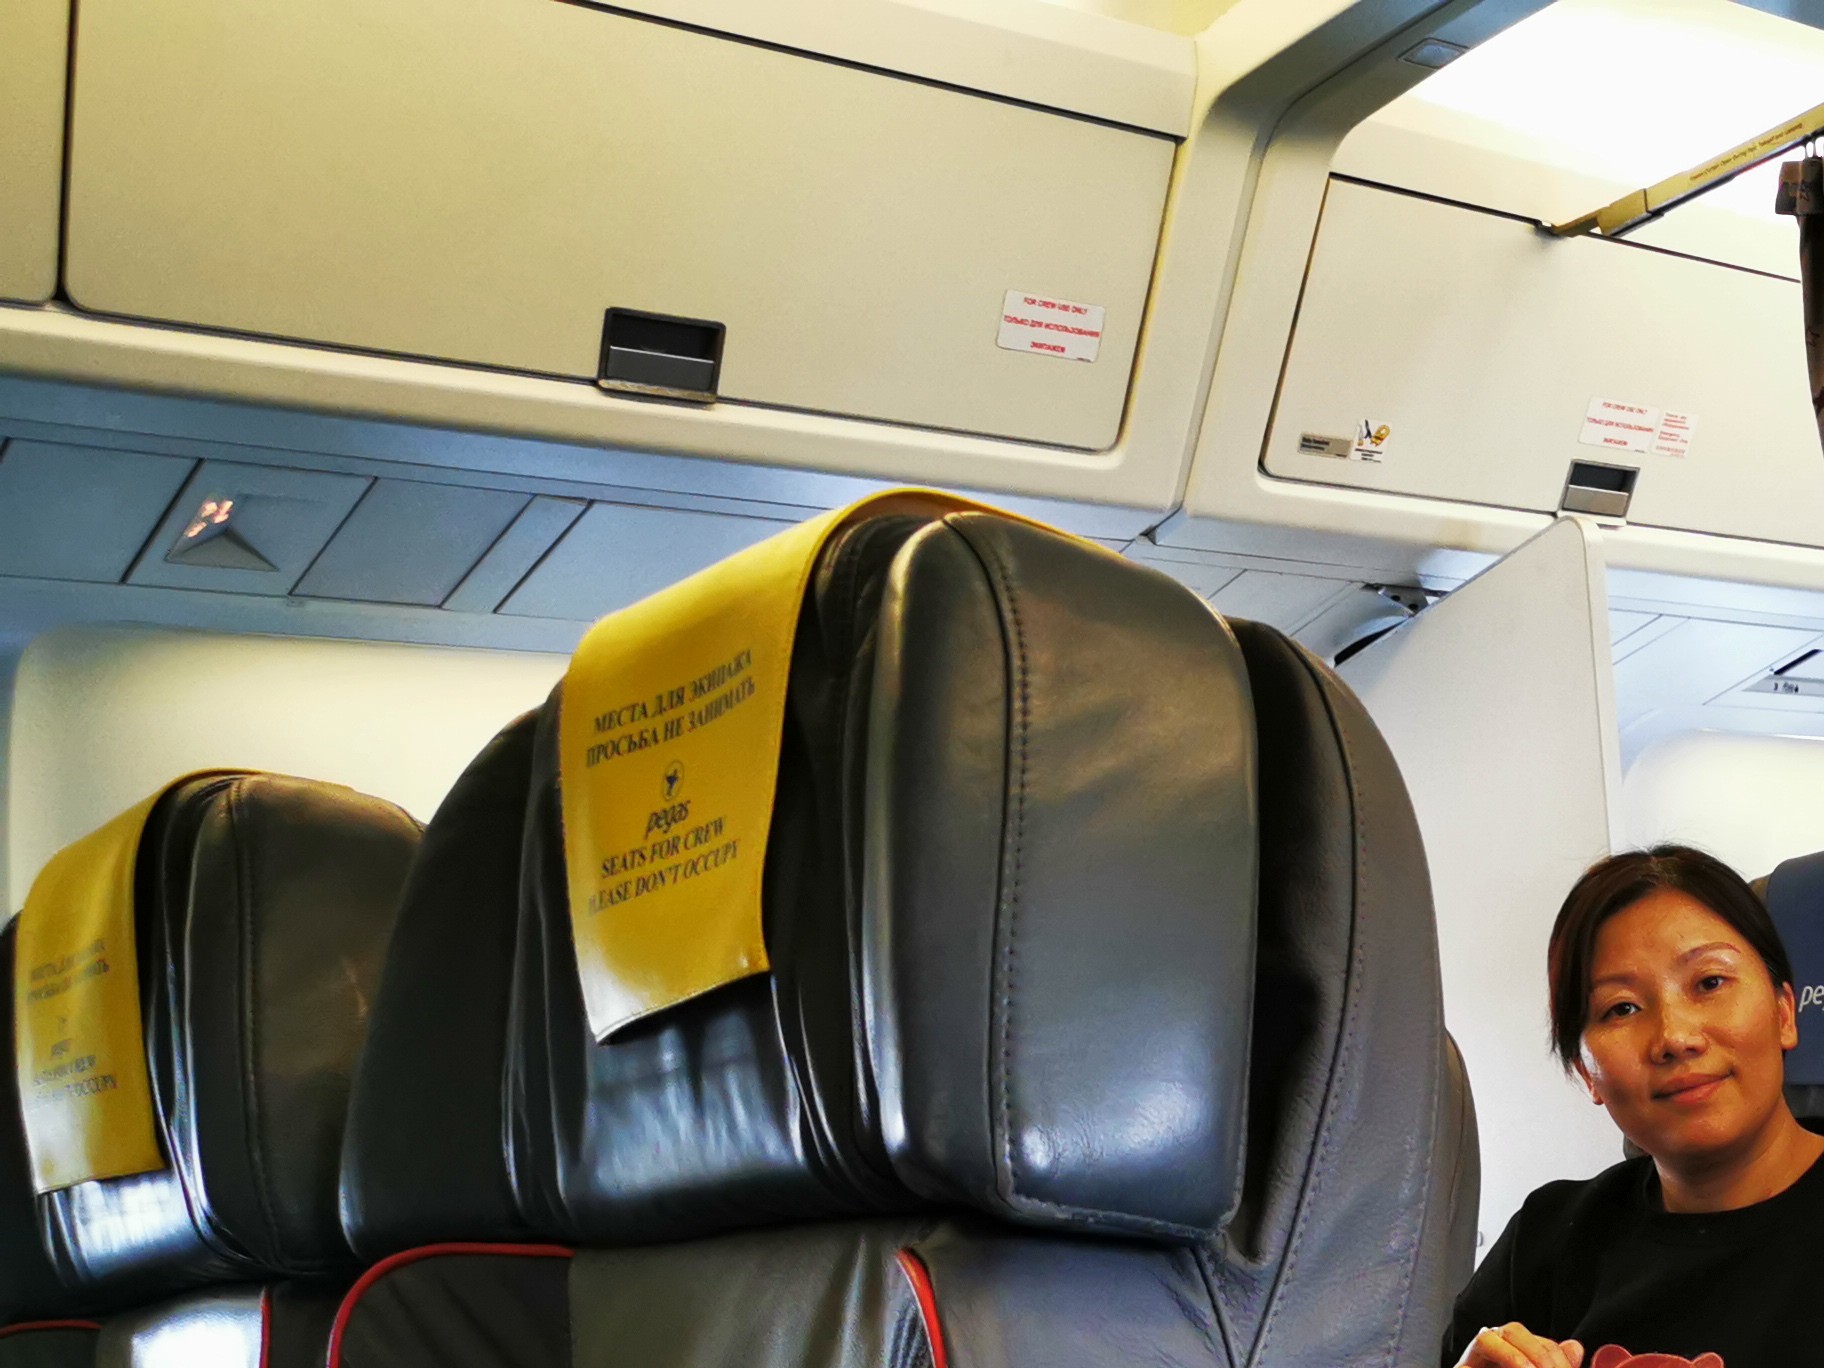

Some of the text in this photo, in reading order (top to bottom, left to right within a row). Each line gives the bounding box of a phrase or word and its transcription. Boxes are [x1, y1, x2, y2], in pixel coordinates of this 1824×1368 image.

[1023, 296, 1037, 306] FOR
[594, 648, 752, 734] МЕСТА ДЛЯ ЭКИПАЖА
[586, 676, 755, 768] ПРОСЬБА НЕ ЗАНИМАТЬ
[601, 816, 725, 879] SEATS FOR CREW
[643, 800, 691, 840] pegas
[635, 862, 682, 898] DON'T
[683, 838, 740, 879] OCCUPY
